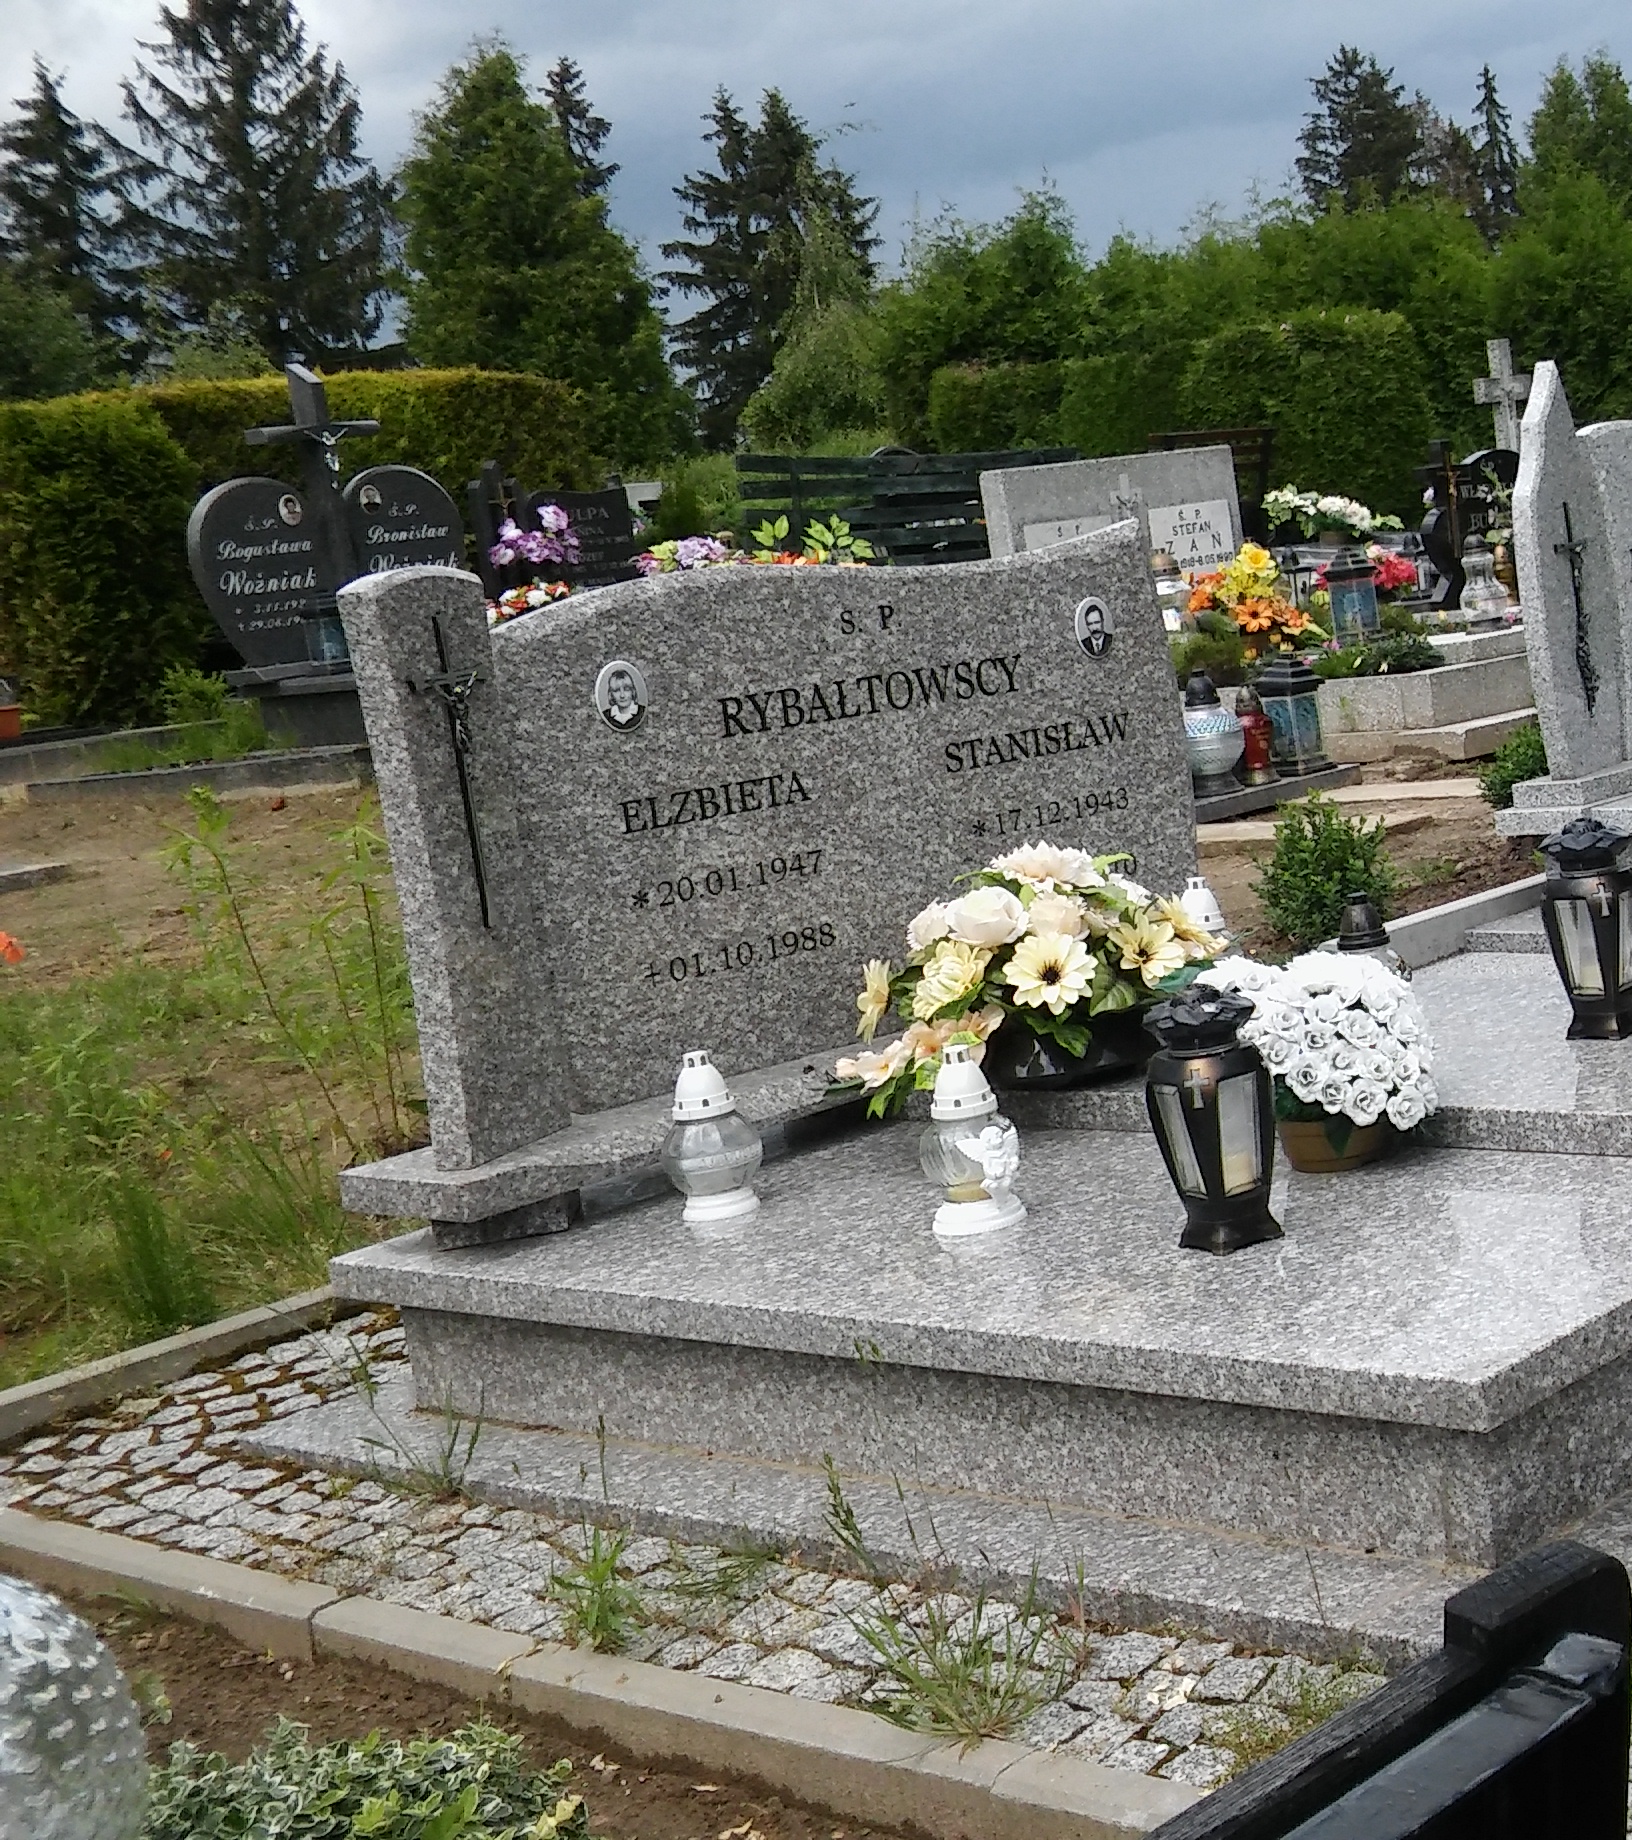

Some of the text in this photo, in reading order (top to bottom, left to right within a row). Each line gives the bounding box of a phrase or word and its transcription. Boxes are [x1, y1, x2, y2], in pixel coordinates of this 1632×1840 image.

[568, 506, 610, 522] ULPA
[1172, 519, 1211, 537] STEFAN
[717, 652, 1022, 739] RYBAŁTOWSCY
[944, 711, 1129, 773] STANISŁAW
